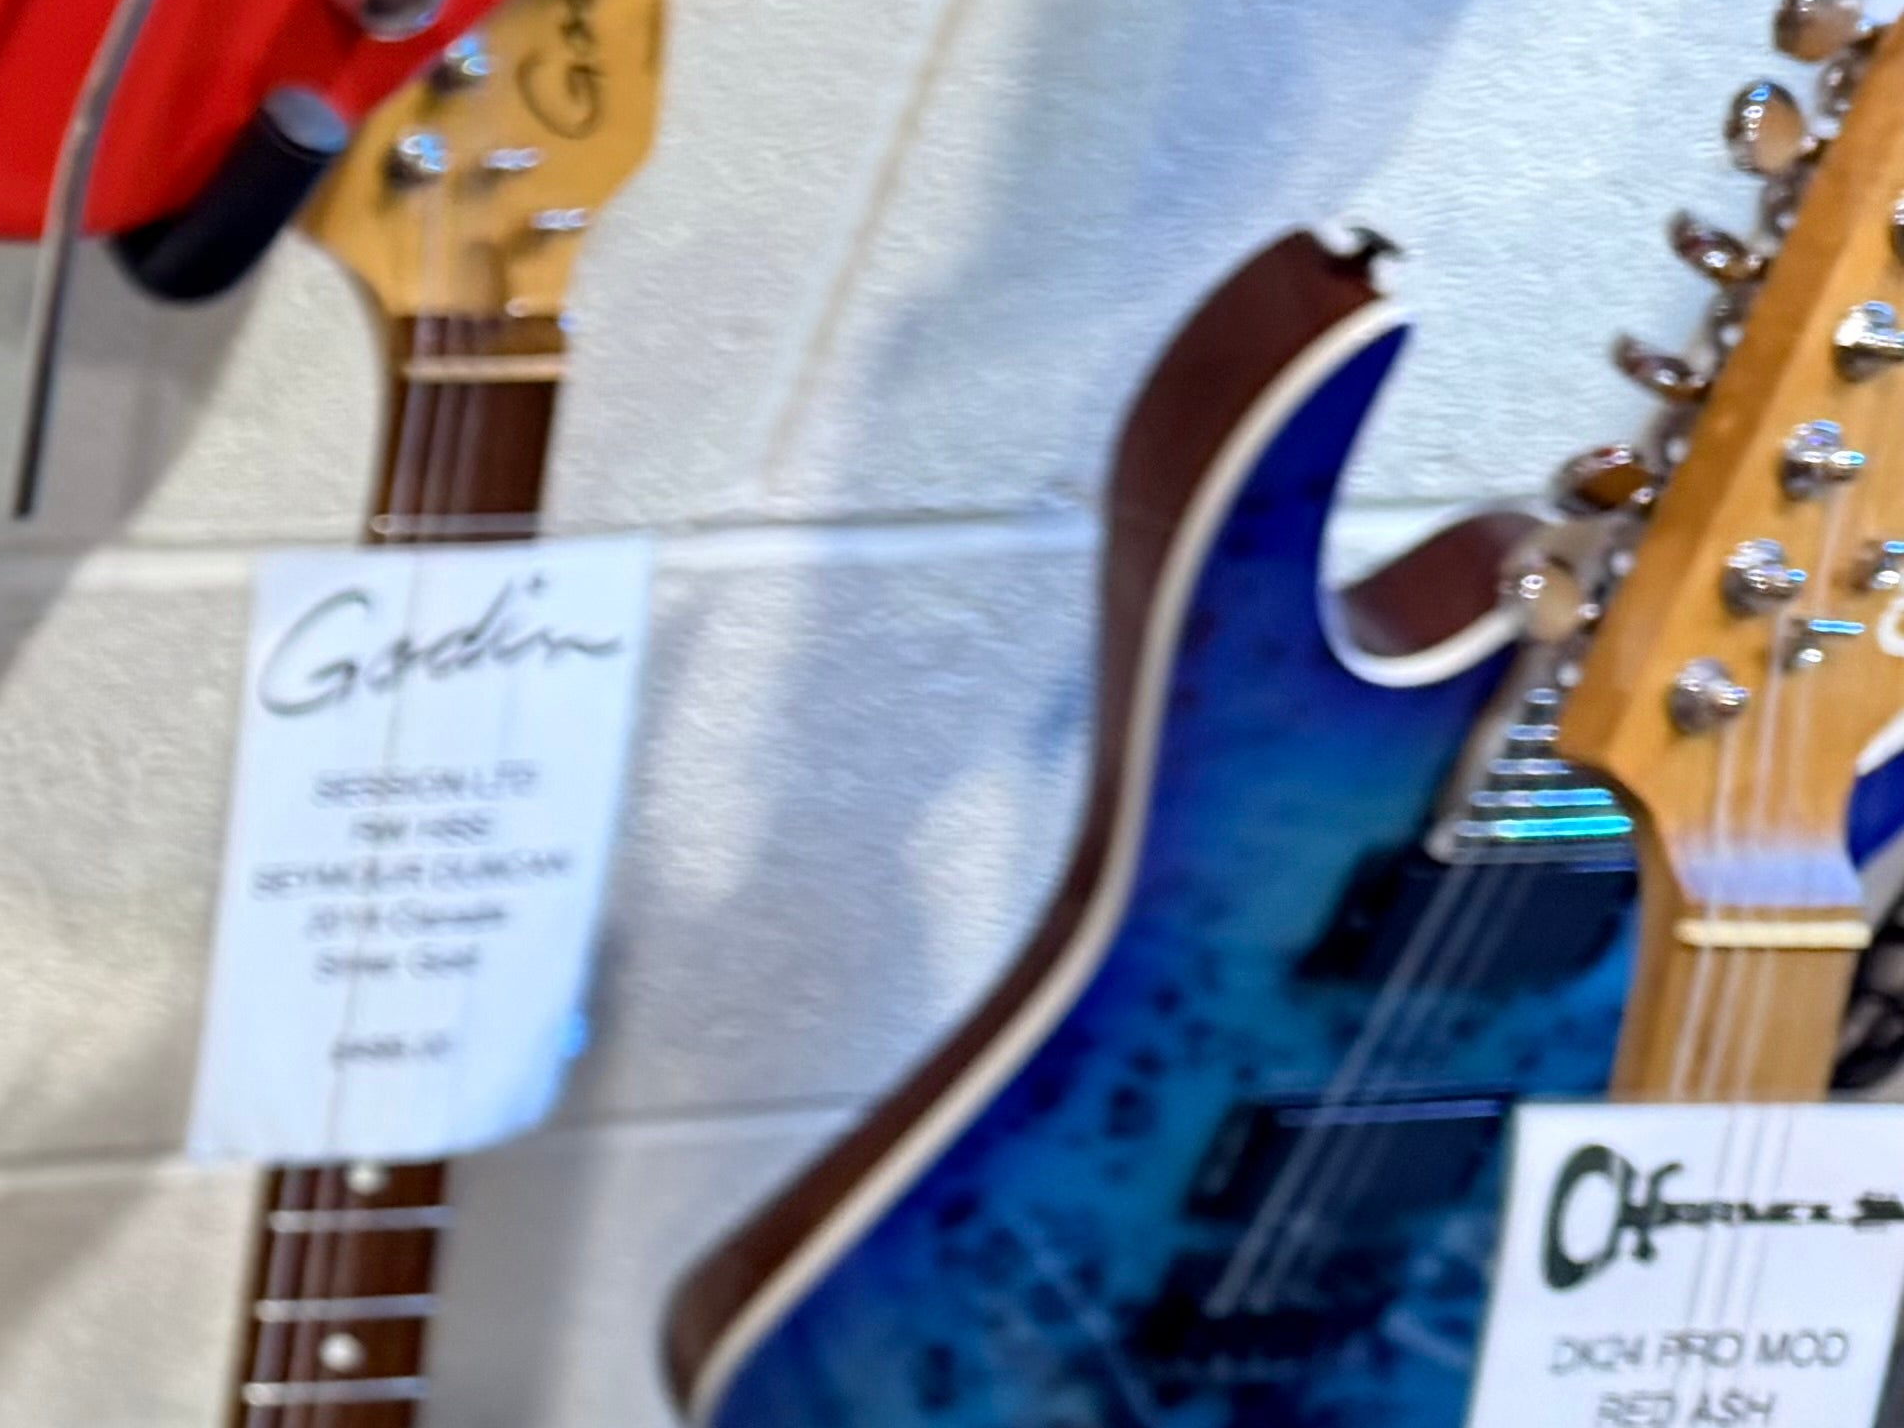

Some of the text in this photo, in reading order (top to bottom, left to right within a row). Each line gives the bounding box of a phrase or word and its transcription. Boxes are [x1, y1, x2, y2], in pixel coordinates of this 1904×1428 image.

[258, 570, 626, 717] Godin
[1658, 1329, 1743, 1368] PRO
[1755, 1327, 1850, 1368] MOD
[1692, 1386, 1776, 1428] ASH
